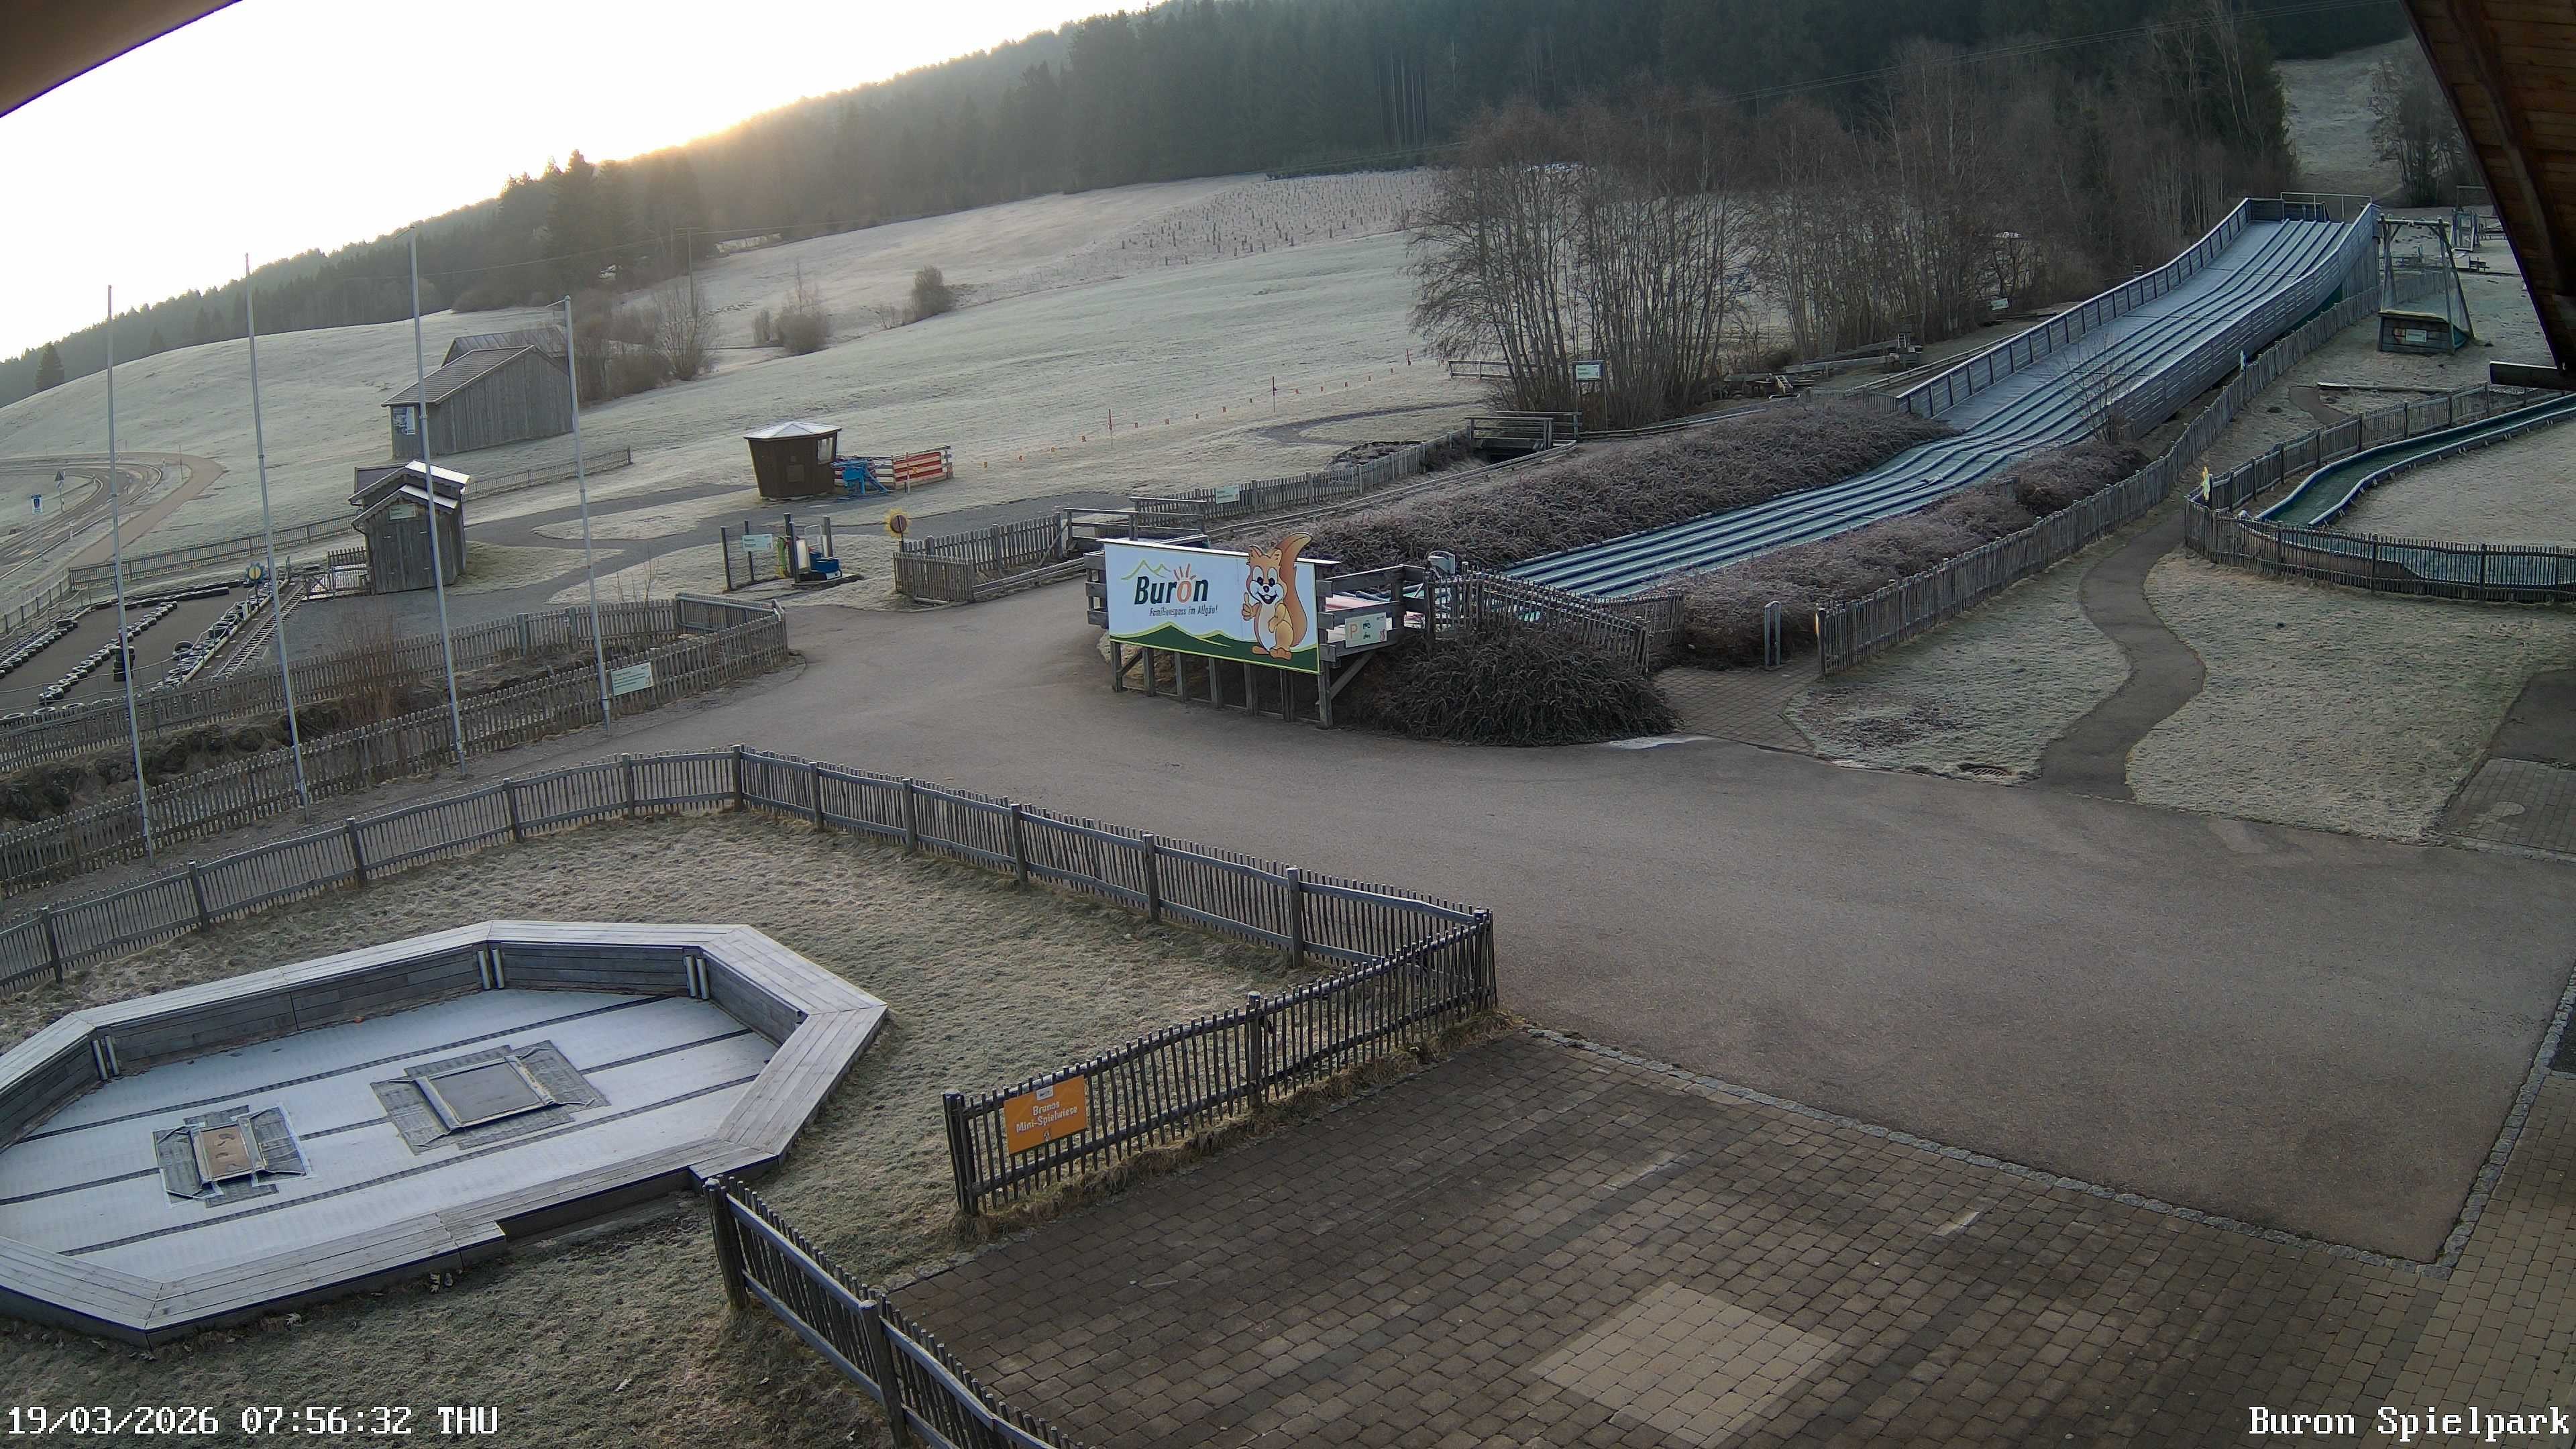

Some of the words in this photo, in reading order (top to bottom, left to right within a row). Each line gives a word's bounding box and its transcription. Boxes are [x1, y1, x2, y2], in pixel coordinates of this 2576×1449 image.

[1134, 576, 1208, 604] Buron
[1350, 623, 1358, 639] P
[1032, 1102, 1059, 1116] Brunos
